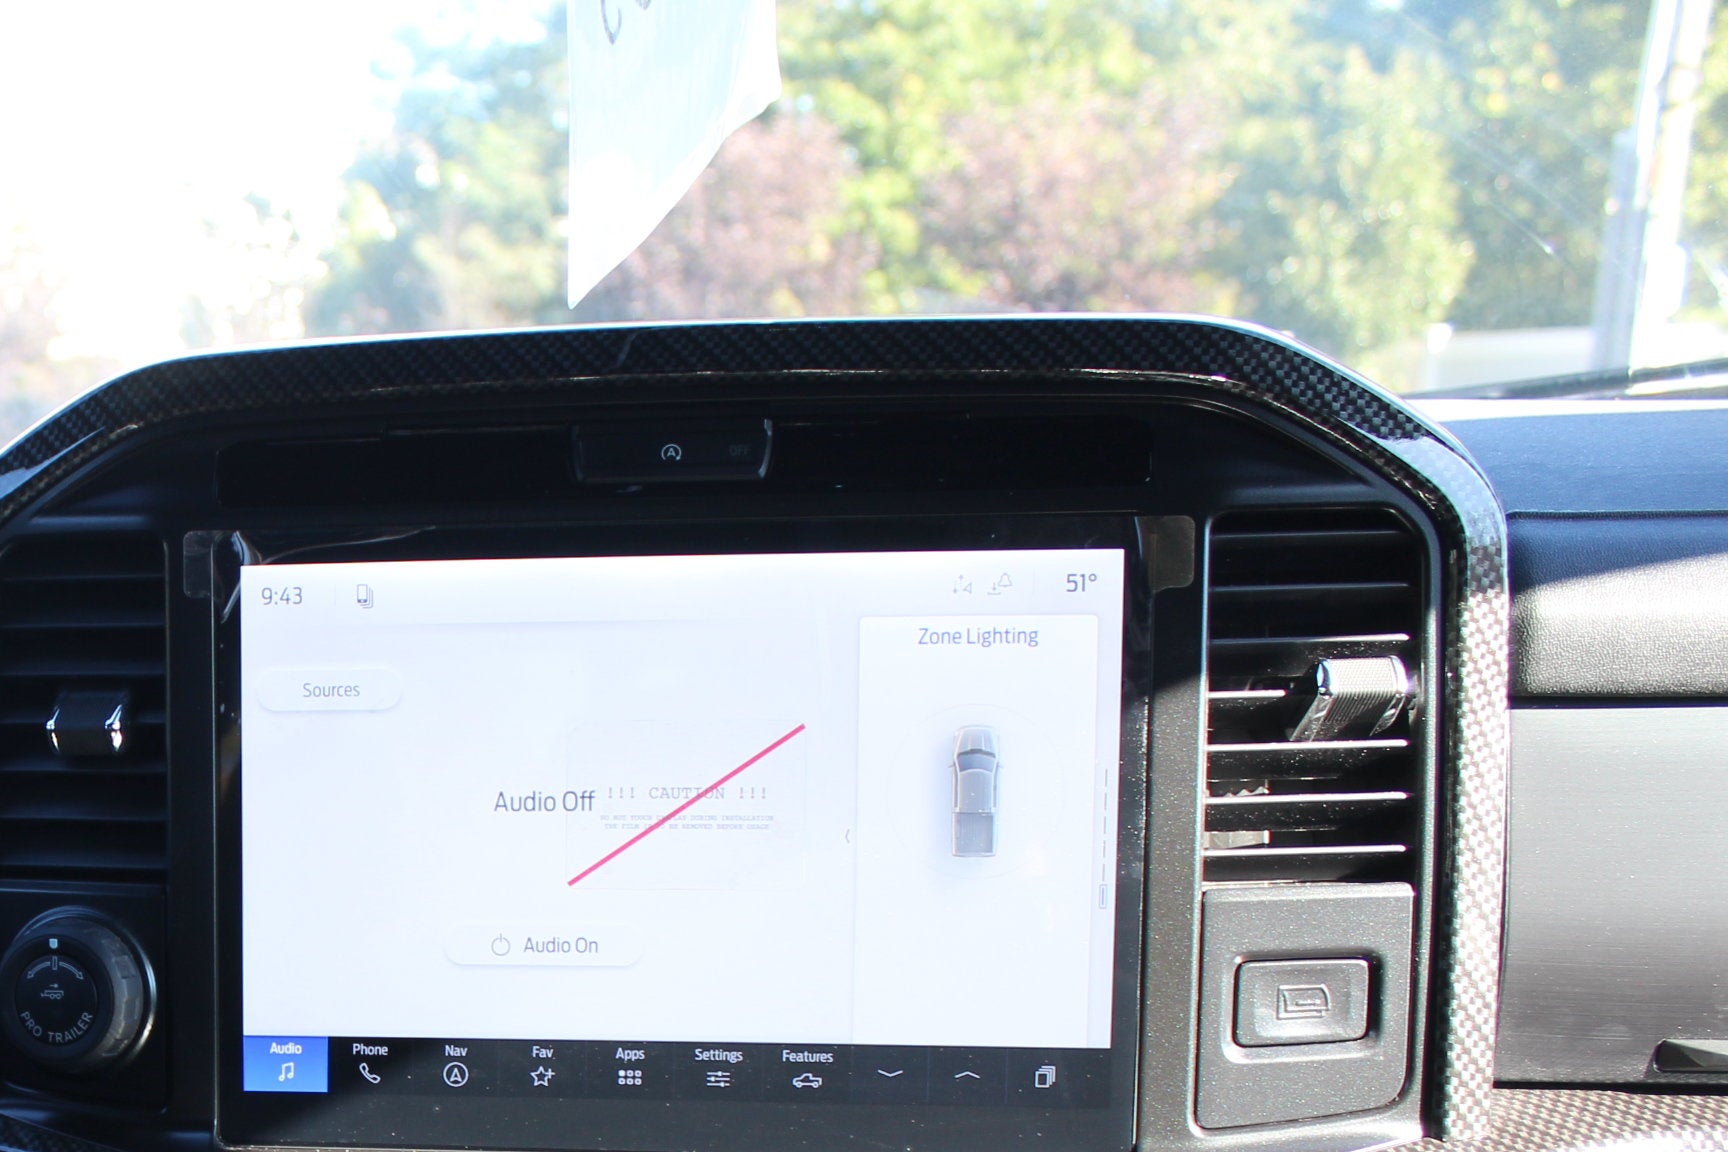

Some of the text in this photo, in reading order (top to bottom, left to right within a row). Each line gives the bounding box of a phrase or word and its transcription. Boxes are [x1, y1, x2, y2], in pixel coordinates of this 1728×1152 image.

[1065, 572, 1098, 593] 51°
[260, 586, 304, 606] 9:43
[917, 626, 1039, 648] Zone Lighting
[302, 682, 361, 699] Sources
[493, 788, 598, 813] Audio Off
[648, 786, 725, 800] CAUTION
[523, 936, 600, 954] Audio On
[19, 1010, 94, 1044] PRO TRAILER
[269, 1041, 303, 1056] Audio
[352, 1042, 389, 1058] Phone
[444, 1044, 468, 1058] Nav
[531, 1046, 554, 1059] Fav
[615, 1047, 645, 1062] Apps
[694, 1048, 744, 1064] Settings
[782, 1049, 834, 1064] Features
